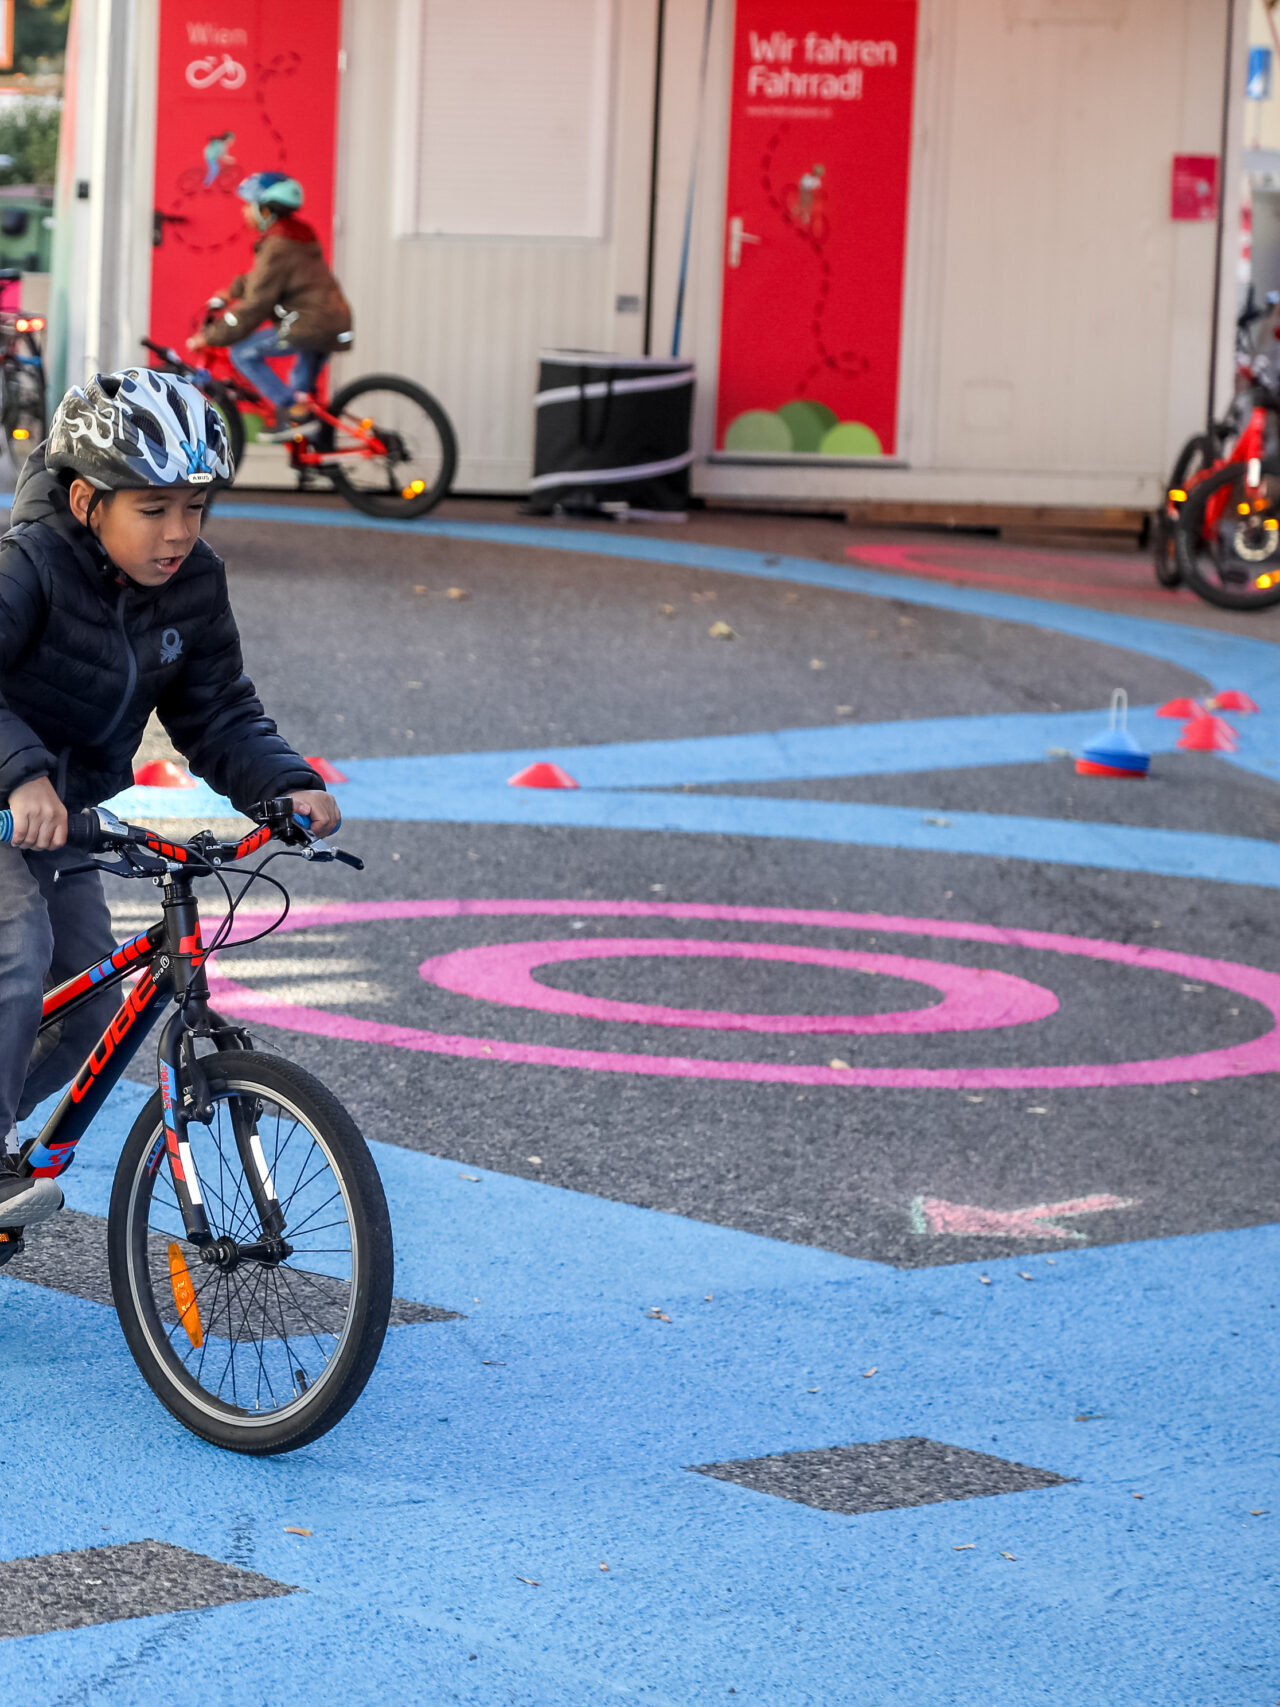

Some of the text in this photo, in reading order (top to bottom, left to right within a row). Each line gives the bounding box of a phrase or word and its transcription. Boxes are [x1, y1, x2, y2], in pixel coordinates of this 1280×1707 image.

[186, 22, 248, 45] Wien
[749, 31, 897, 66] Wir fahren
[747, 65, 863, 100] Fahrrad!
[71, 965, 157, 1104] CUBE
